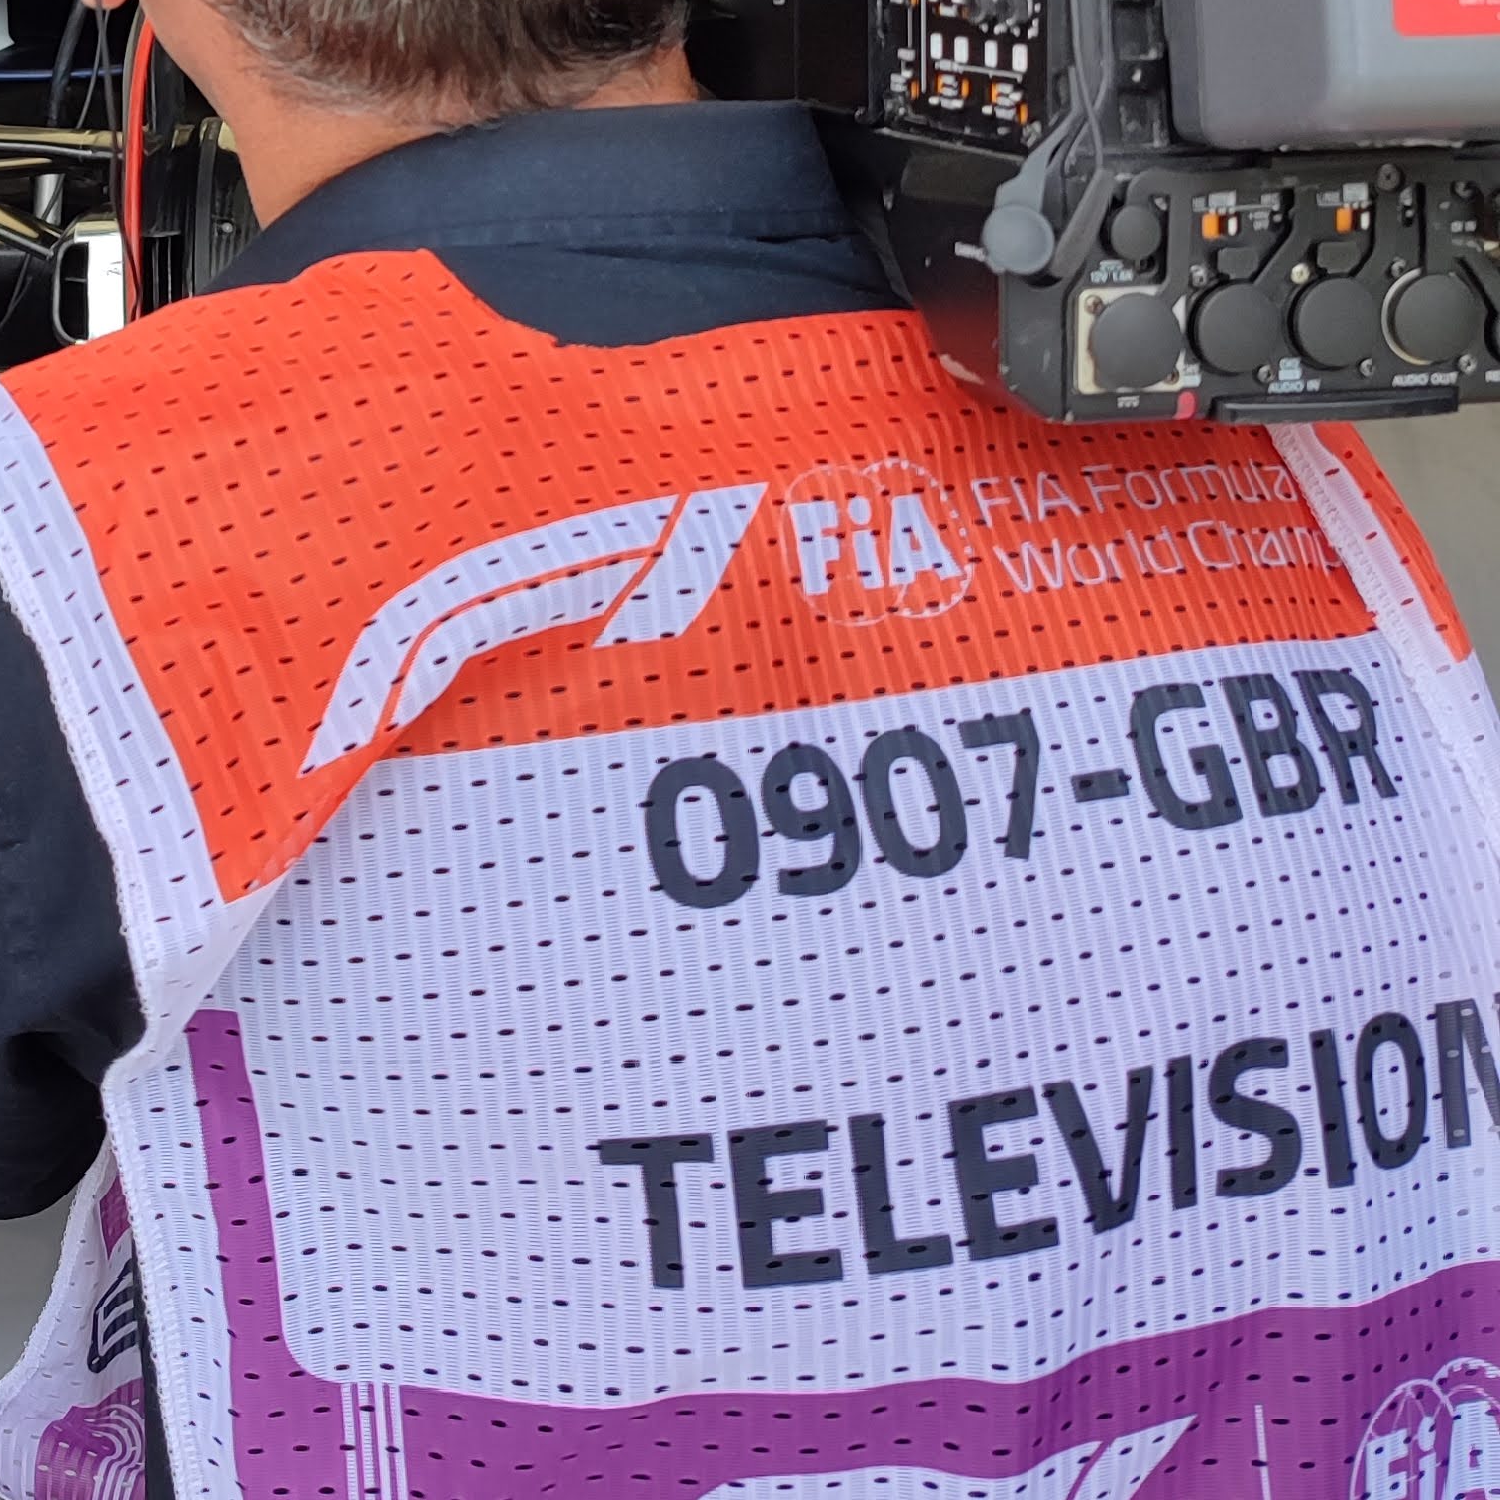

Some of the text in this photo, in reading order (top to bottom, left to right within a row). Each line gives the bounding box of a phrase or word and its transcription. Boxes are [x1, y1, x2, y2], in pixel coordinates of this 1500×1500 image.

[971, 458, 1297, 526] FIA Formula
[994, 525, 1182, 593] World
[644, 668, 1398, 909] 0907-GBR
[599, 991, 1500, 1290] TELEVISION
